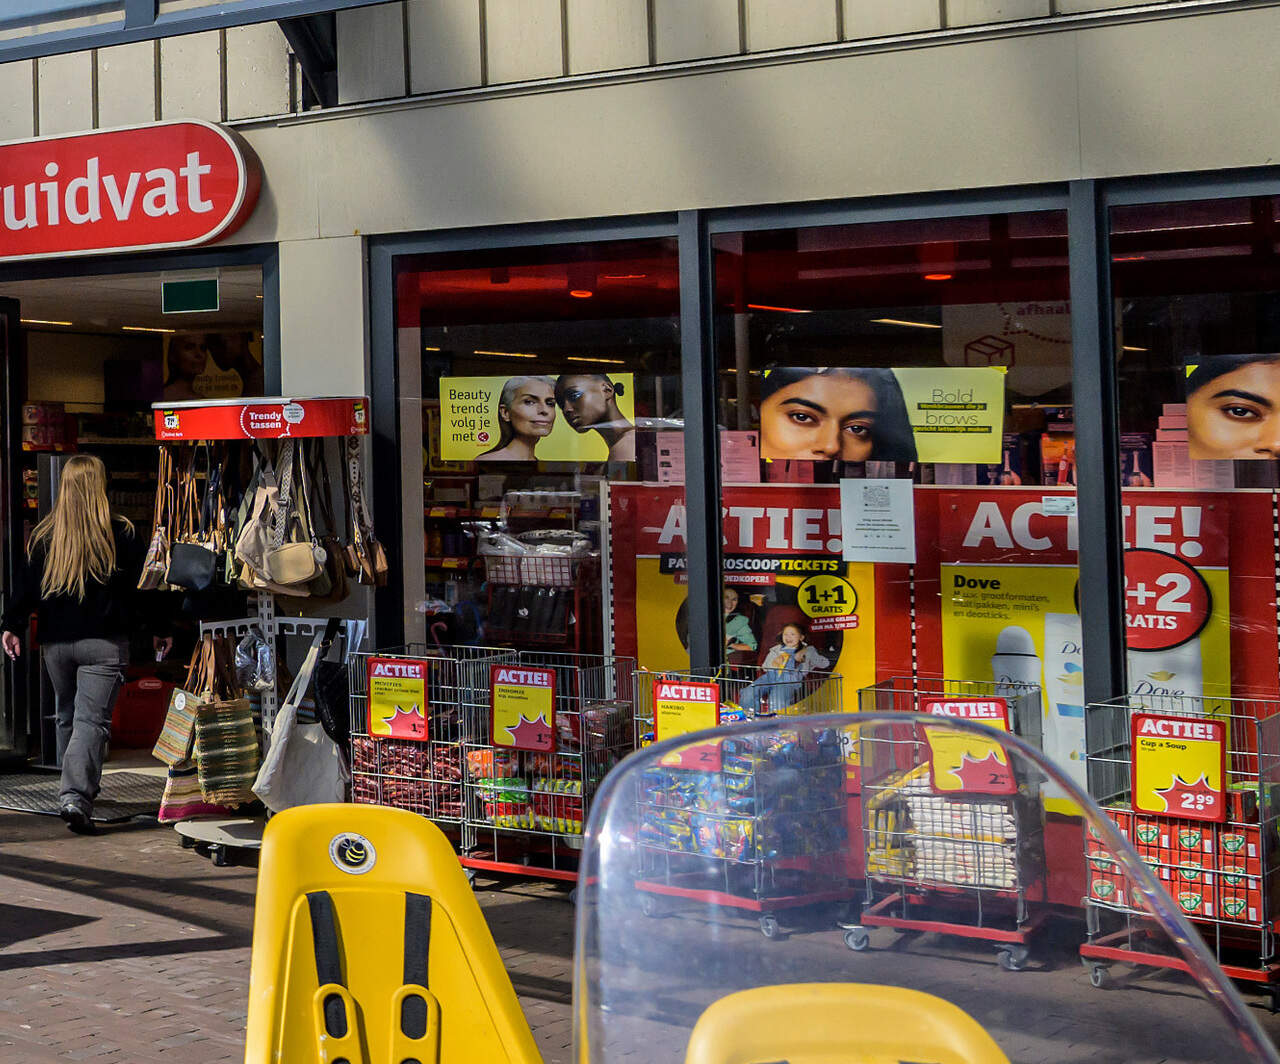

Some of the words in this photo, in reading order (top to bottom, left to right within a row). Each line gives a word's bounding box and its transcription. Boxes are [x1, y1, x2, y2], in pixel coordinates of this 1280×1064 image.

[1016, 302, 1071, 316] afhaal
[449, 389, 491, 402] Beauty
[932, 388, 973, 403] Bold
[451, 402, 489, 414] trends
[249, 411, 282, 422] Trendy
[451, 416, 475, 430] volg
[478, 416, 490, 430] je
[926, 411, 978, 425] brows
[250, 421, 282, 429] tassen
[452, 432, 475, 441] met
[657, 504, 844, 553] ATIE!
[962, 501, 1203, 558] ACE!
[723, 558, 839, 572] IOSCOOPTICKETS
[724, 574, 770, 584] OEDKOPER!
[953, 574, 1001, 590] Dove
[804, 585, 848, 604] 1+1
[1124, 572, 1192, 613] +2
[811, 605, 843, 614] GRATIS
[1125, 614, 1177, 630] RATIS
[374, 663, 421, 678] ACTIE!
[498, 669, 548, 686] ACTIE!
[660, 684, 712, 701] ACTIE!
[1134, 679, 1185, 696] Dove
[931, 702, 997, 717] ACTIE!
[1141, 718, 1214, 740] ACTIE!
[1140, 739, 1157, 748] Cup
[1165, 741, 1187, 750] Soup
[1180, 792, 1215, 810] 2.99
